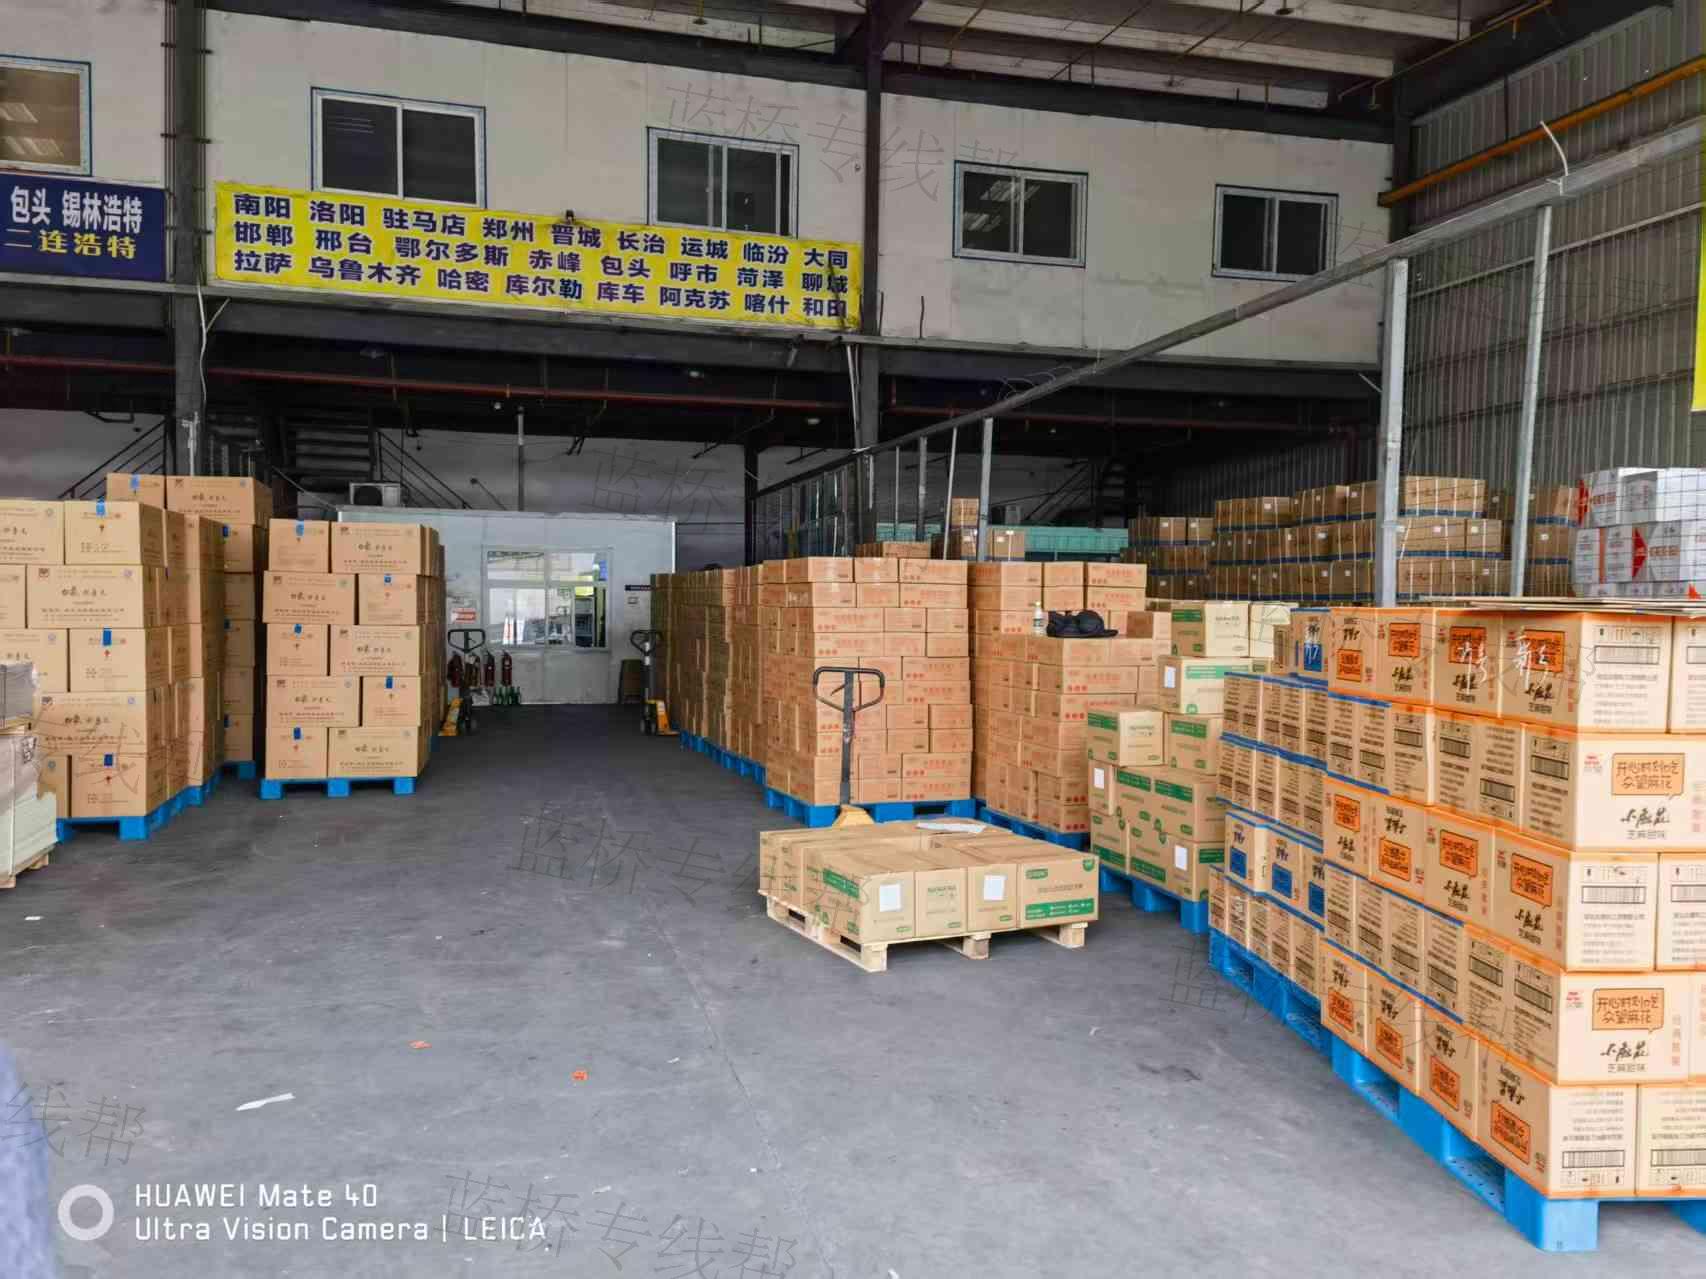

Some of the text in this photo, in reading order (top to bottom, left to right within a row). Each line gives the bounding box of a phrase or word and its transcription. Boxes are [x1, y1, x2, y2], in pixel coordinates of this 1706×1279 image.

[10, 185, 144, 235] 包头 锡林浩特
[234, 193, 849, 269] 南阳 洛阳 驻马店 郑州 晋城 长治 运城 临汾 大同
[5, 229, 137, 261] 二连浩特
[234, 221, 848, 294] 邯郸 邢台 鄂尔多斯 赤峰 包头 呼市 菏泽 聊城
[234, 251, 847, 318] 拉萨 乌鲁木齐 哈密 库尔勒 库车 阿克苏 喀什 和田
